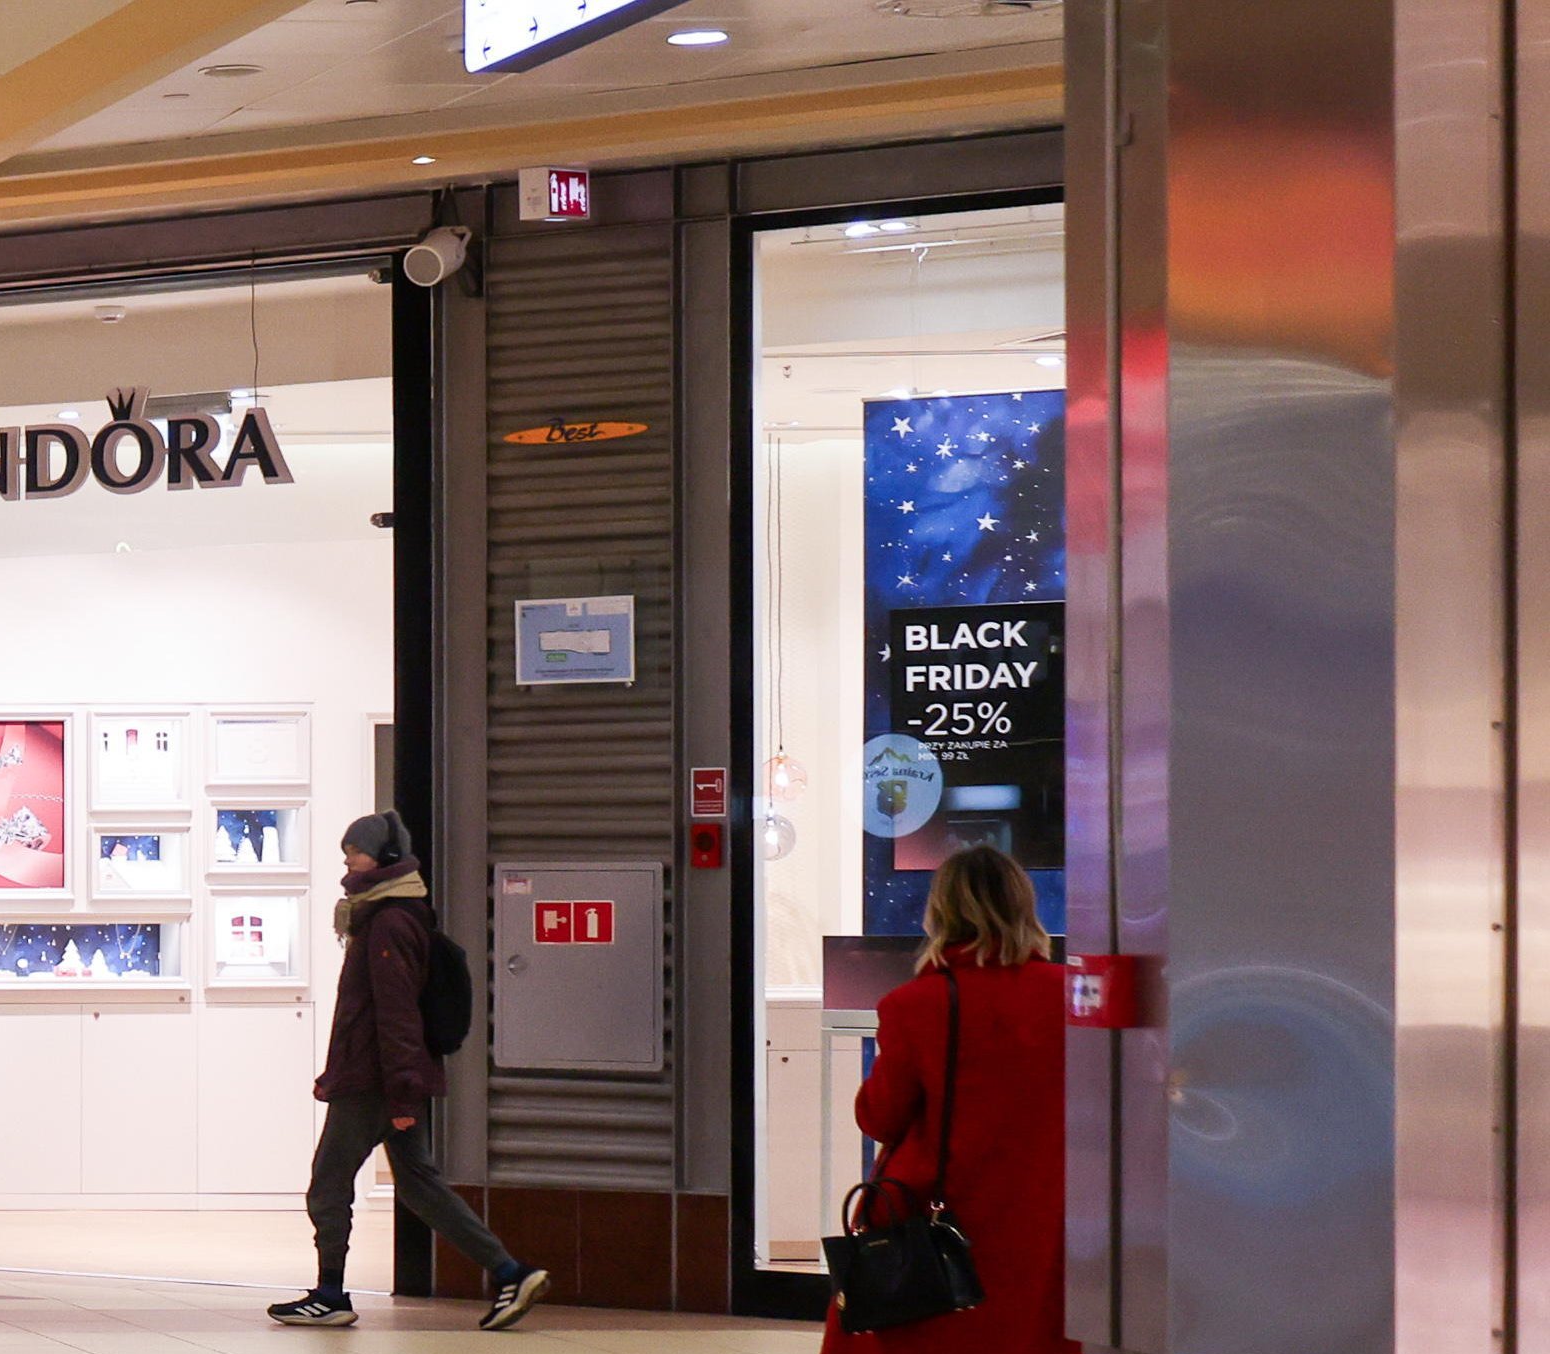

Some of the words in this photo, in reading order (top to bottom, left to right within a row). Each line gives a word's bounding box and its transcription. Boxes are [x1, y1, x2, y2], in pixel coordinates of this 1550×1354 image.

[546, 417, 605, 442] Best
[905, 620, 1029, 651] BLACK
[906, 661, 1039, 692] FRIDAY
[907, 701, 1012, 736] -25%
[917, 741, 945, 751] PRZY
[947, 740, 990, 751] ZAKUPIE
[993, 740, 1009, 749] ZA
[941, 752, 954, 761] 99
